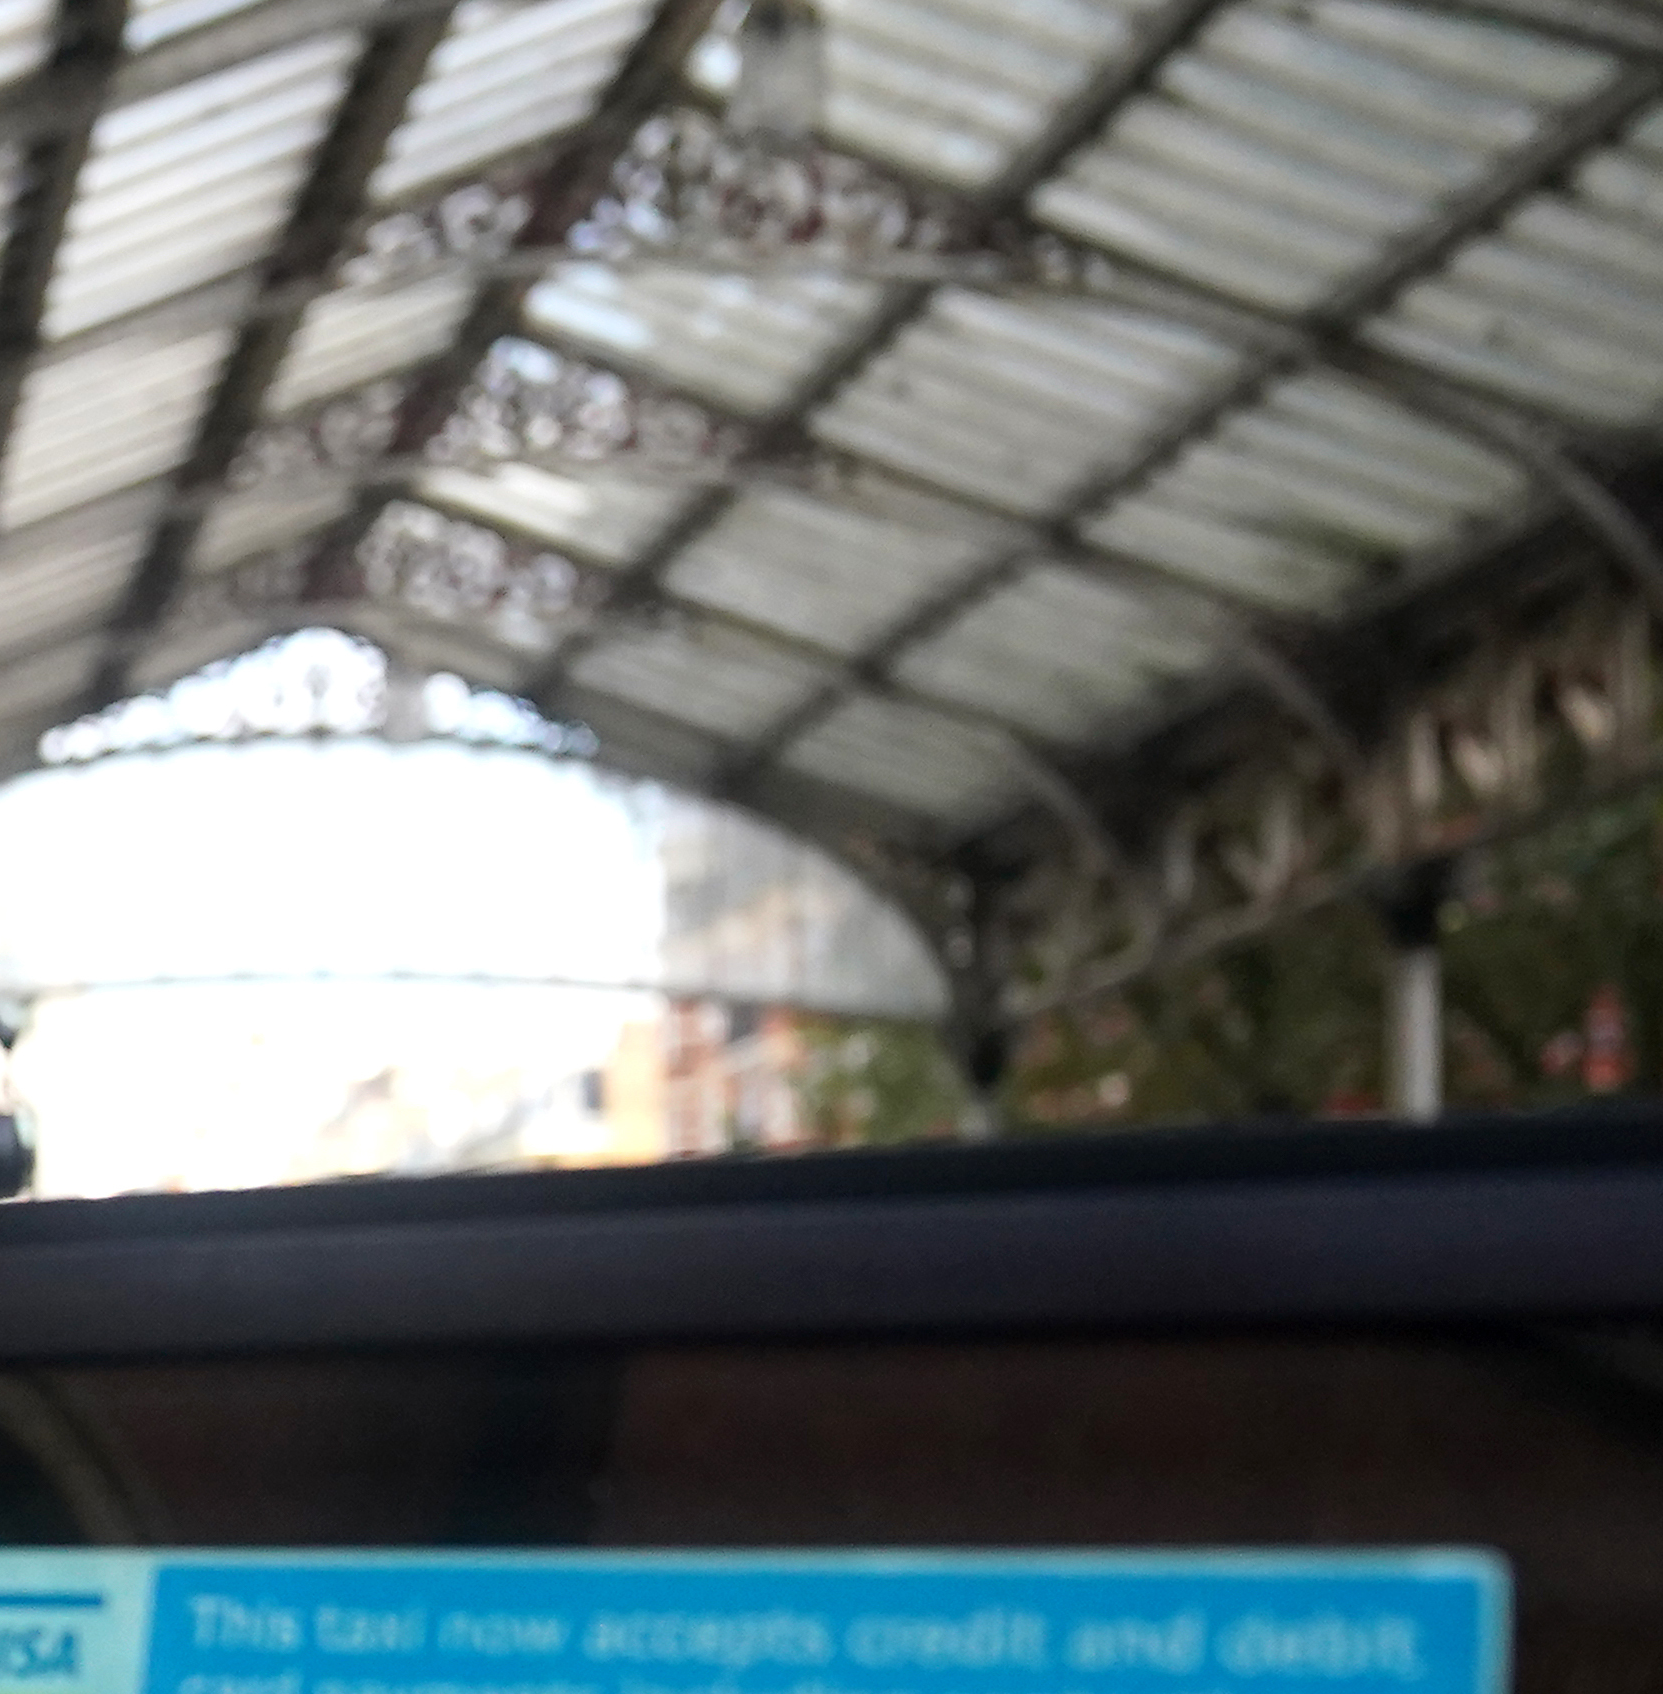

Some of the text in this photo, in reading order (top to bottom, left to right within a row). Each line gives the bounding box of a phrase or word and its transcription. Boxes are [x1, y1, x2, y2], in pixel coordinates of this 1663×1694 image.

[192, 1595, 300, 1653] This
[314, 1604, 427, 1654] taxi
[437, 1610, 563, 1656] now
[582, 1609, 834, 1669] accepts
[845, 1608, 1049, 1670] credit
[1067, 1608, 1208, 1673] and
